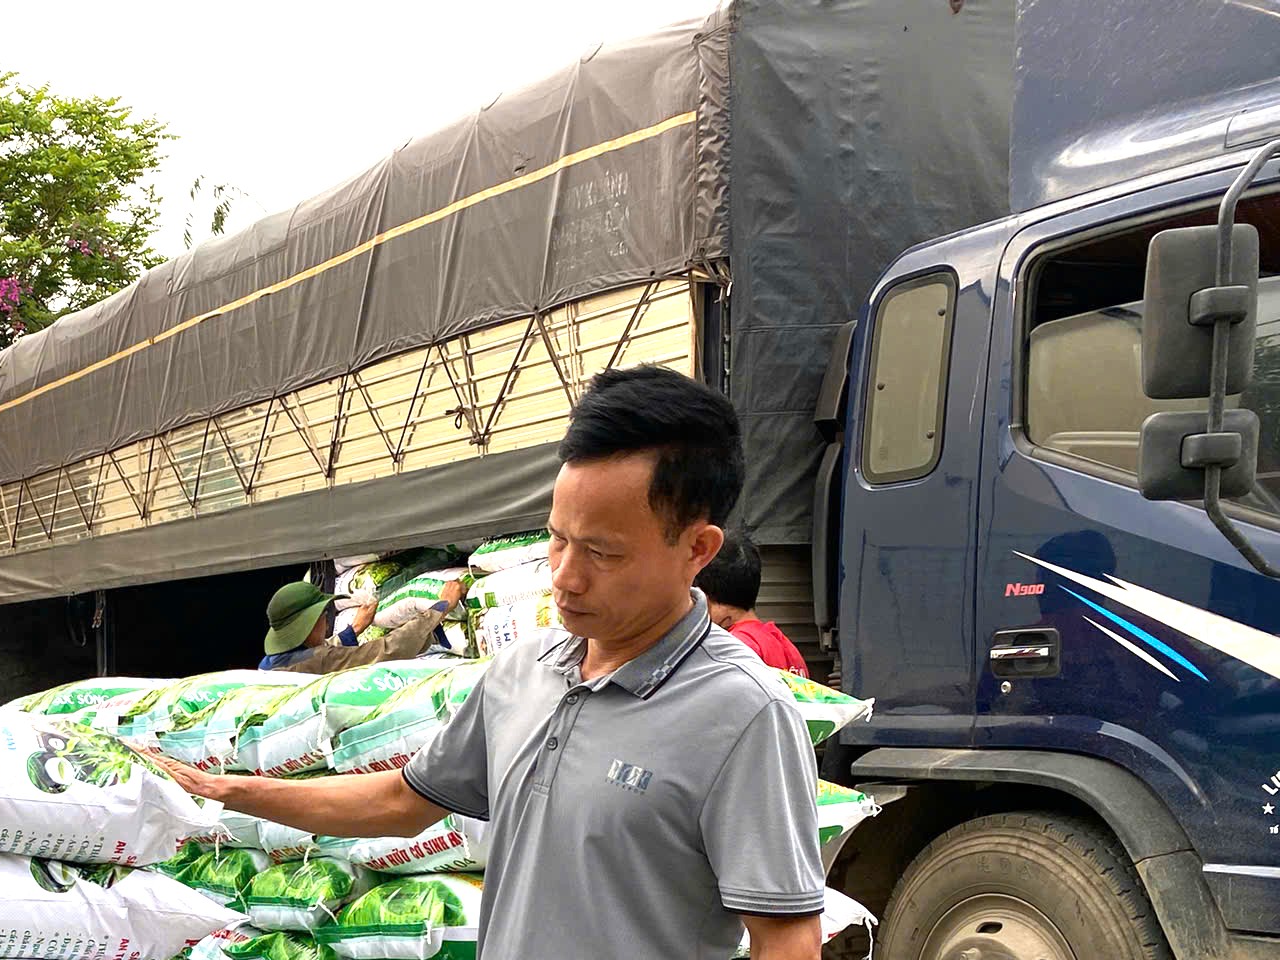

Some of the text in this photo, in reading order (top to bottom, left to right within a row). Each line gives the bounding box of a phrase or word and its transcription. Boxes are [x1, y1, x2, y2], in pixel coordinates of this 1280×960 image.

[1004, 582, 1045, 597] N900
[386, 836, 449, 867] HỮU CƠ SINH
